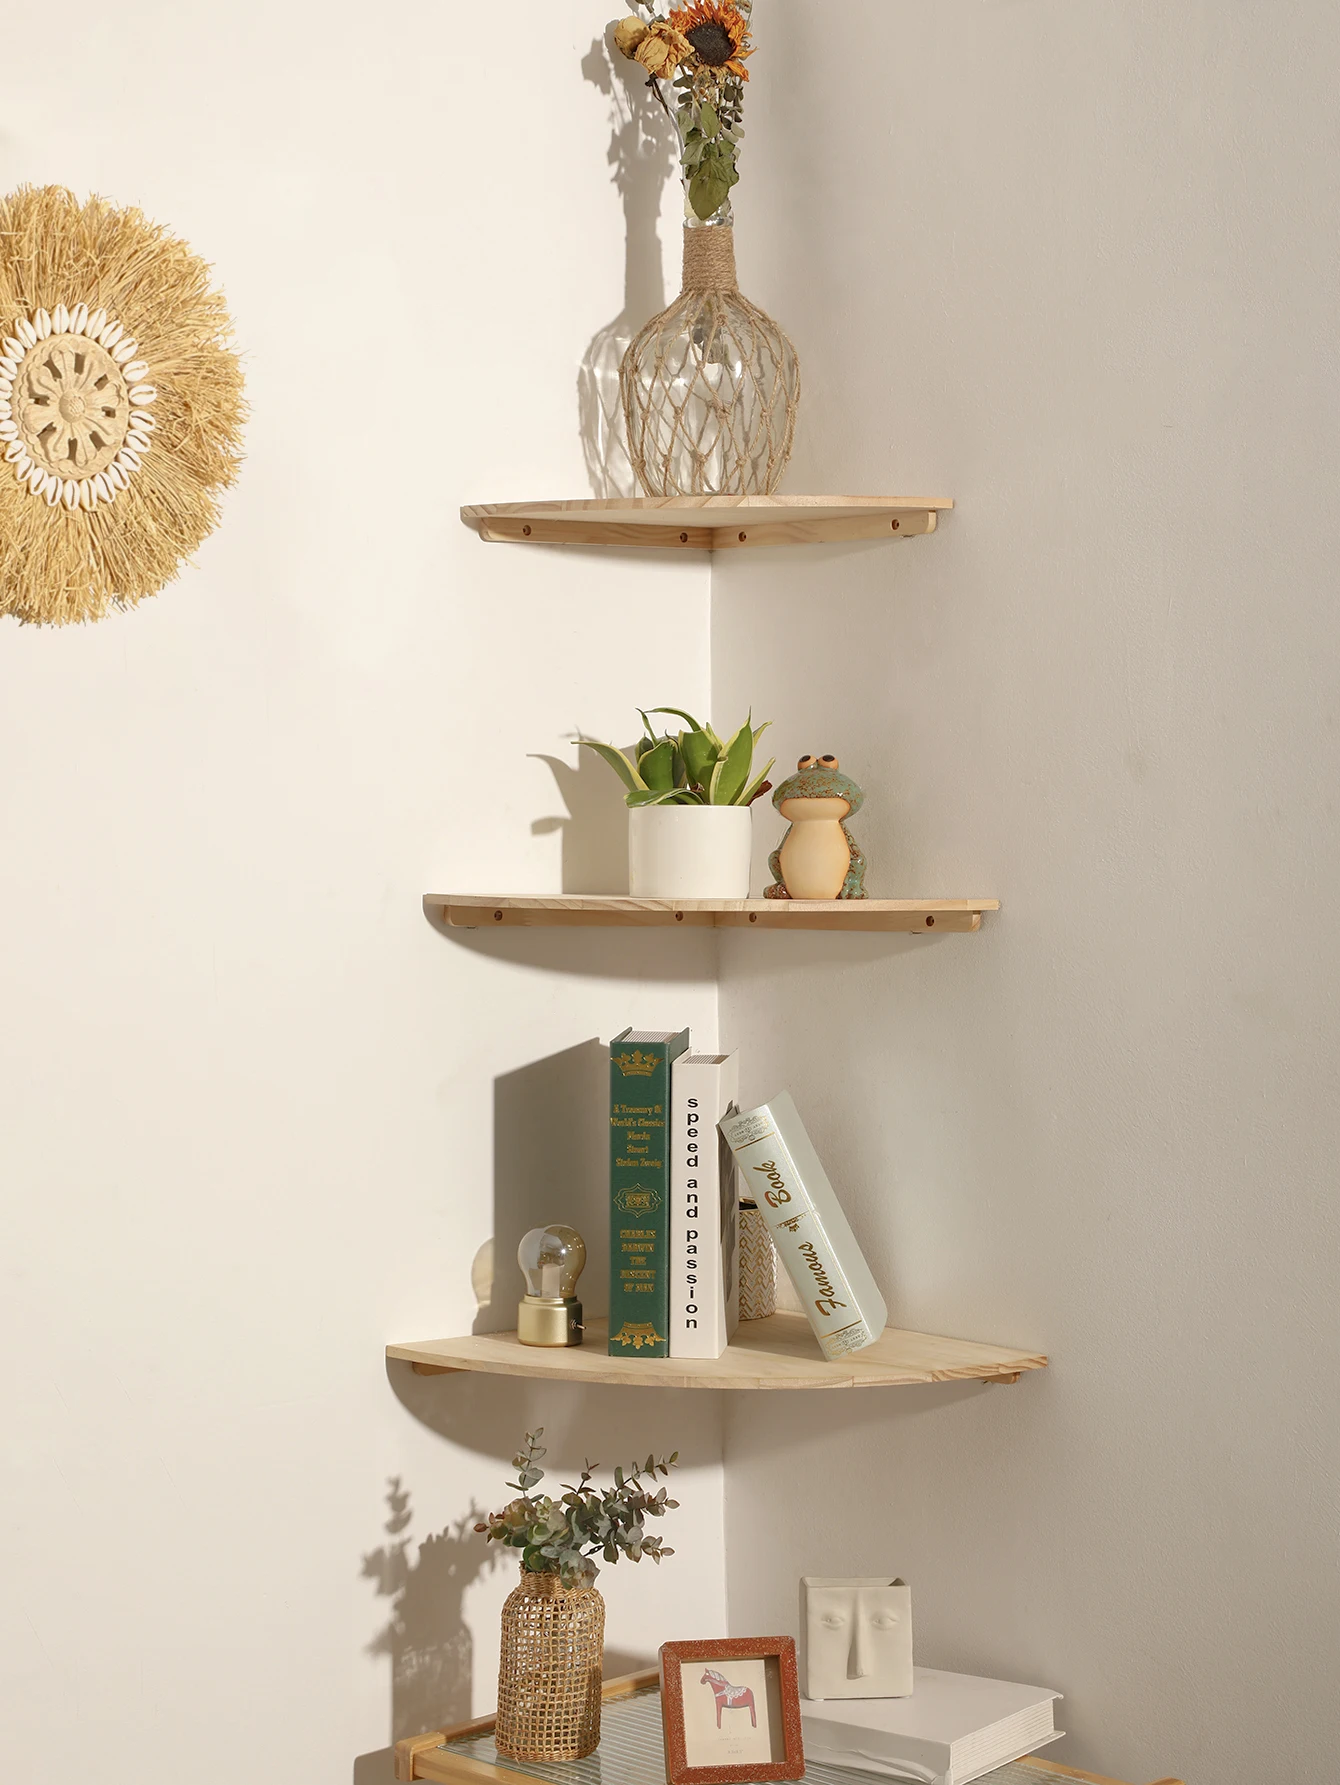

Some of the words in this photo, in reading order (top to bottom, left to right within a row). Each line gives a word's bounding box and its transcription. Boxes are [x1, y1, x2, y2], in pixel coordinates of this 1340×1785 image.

[686, 1098, 699, 1168] speed
[686, 1178, 699, 1219] and
[752, 1160, 792, 1209] Book
[685, 1228, 699, 1329] passion
[798, 1241, 847, 1316] Famous
